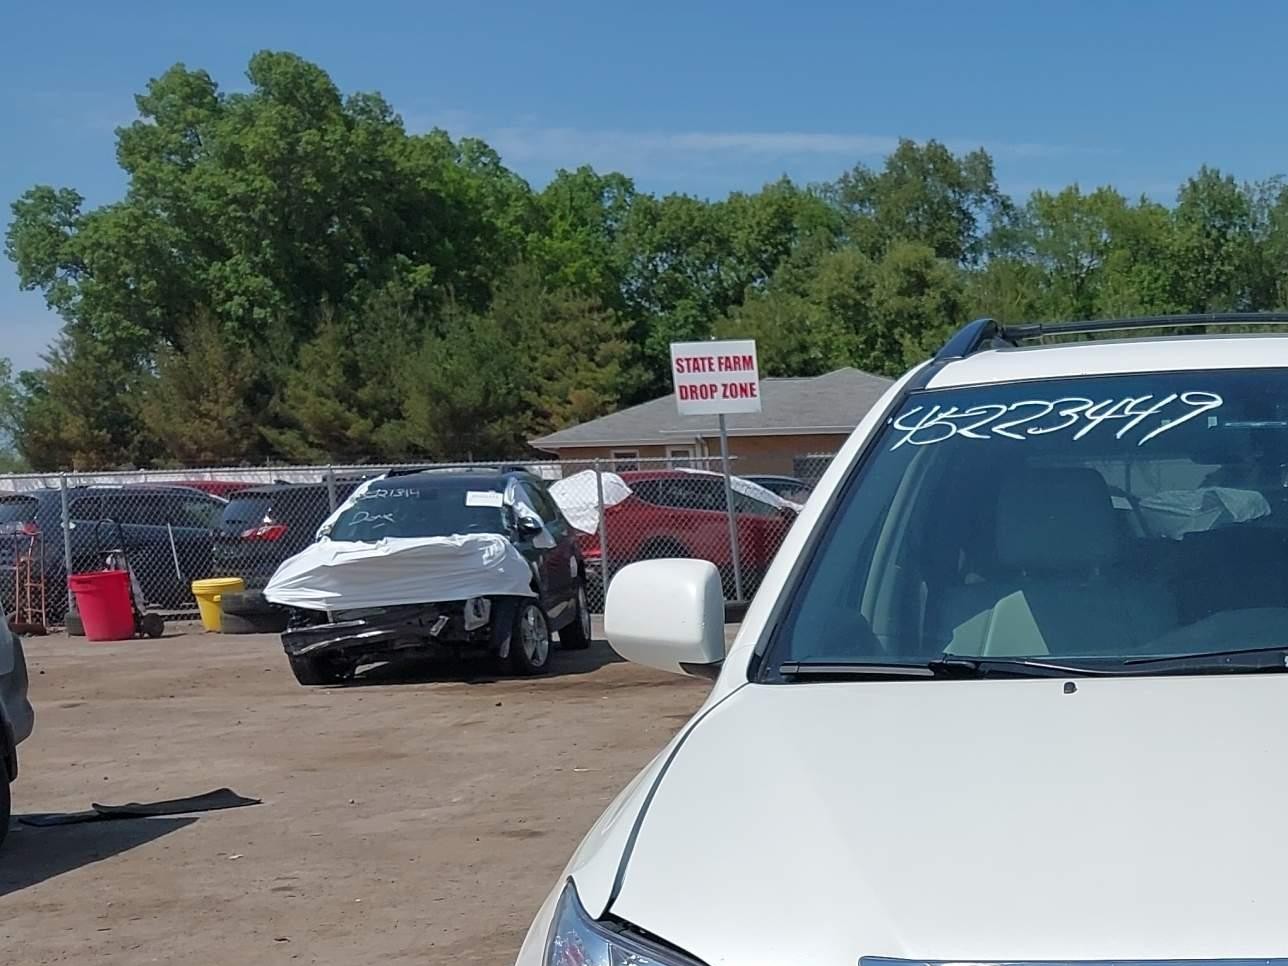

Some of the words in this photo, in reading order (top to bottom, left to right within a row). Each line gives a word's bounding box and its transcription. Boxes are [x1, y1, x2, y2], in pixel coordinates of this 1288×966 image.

[675, 356, 716, 374] STATE
[717, 355, 755, 372] FARM
[678, 383, 718, 401] DROP
[721, 382, 758, 399] ZONE
[890, 391, 1224, 452] 45223449
